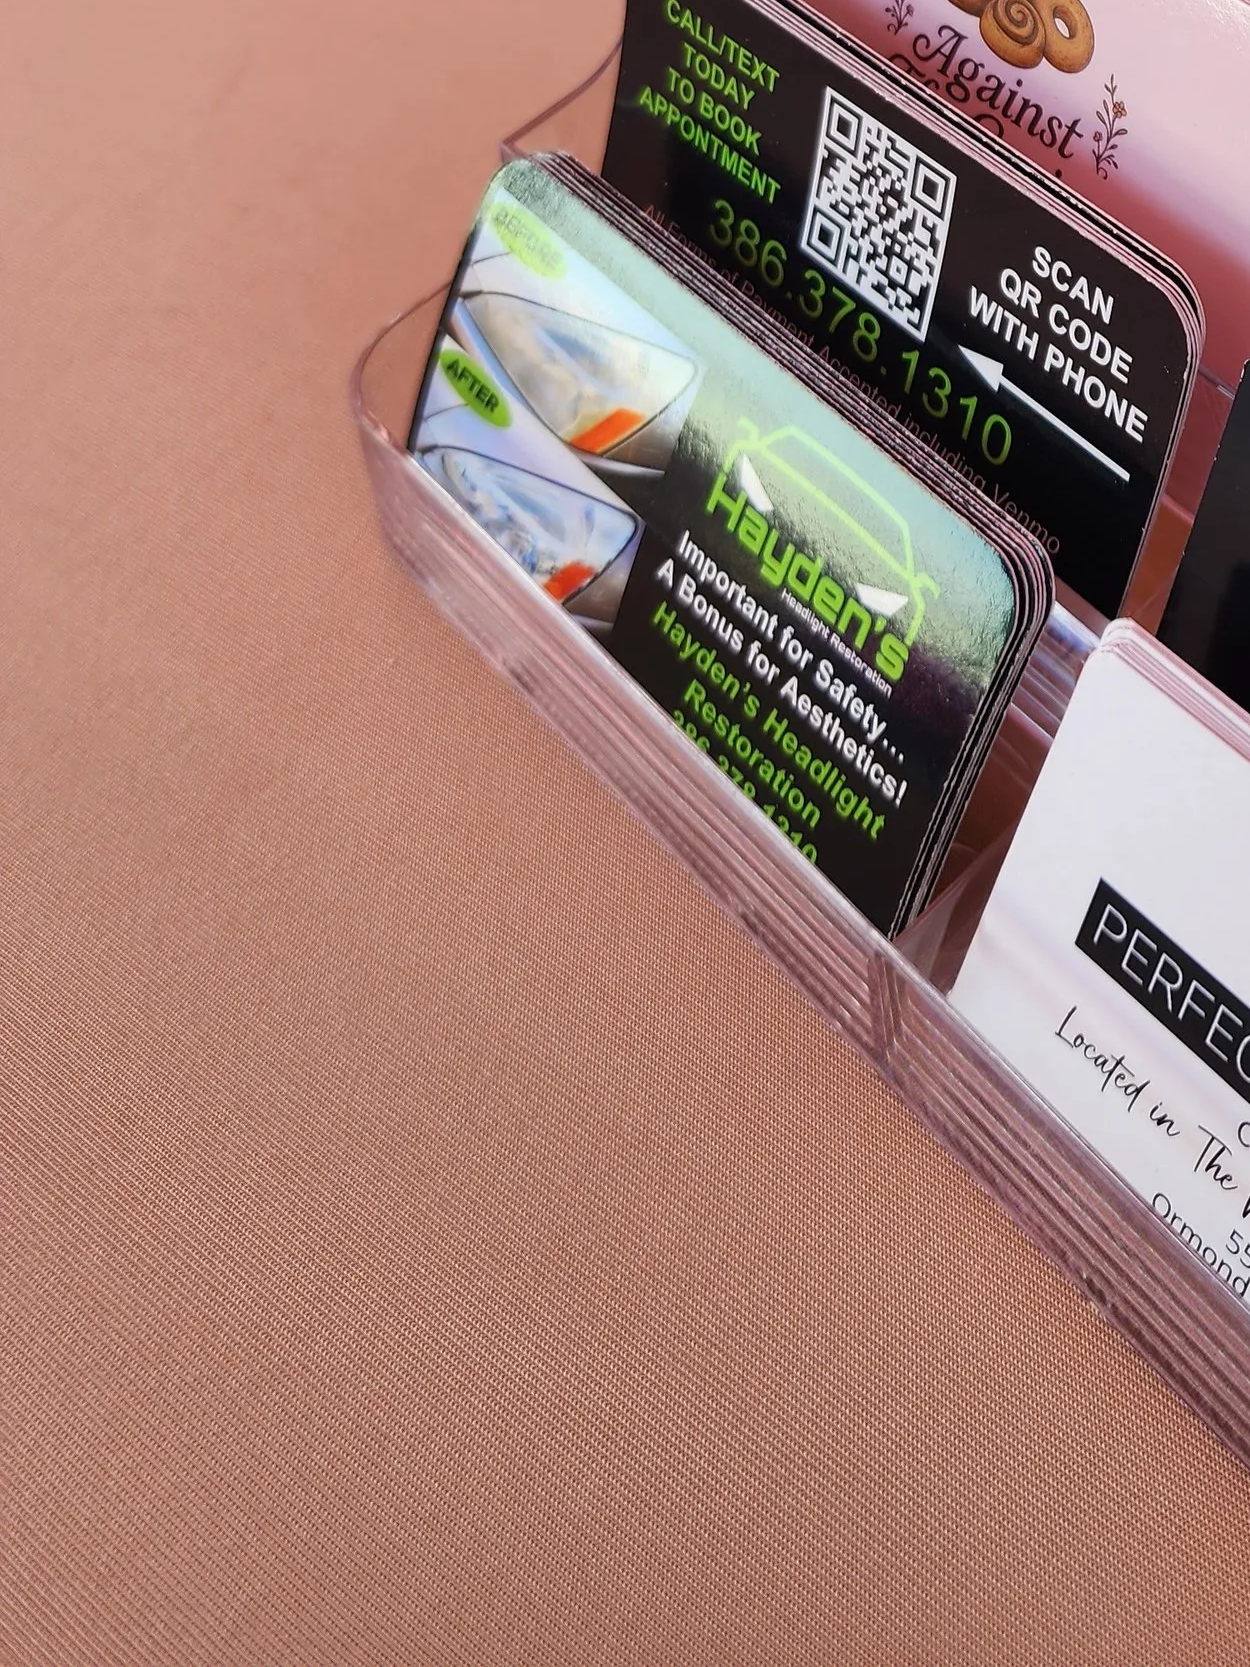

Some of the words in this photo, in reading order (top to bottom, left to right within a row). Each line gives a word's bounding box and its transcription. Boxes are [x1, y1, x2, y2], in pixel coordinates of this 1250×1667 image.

[638, 85, 782, 204] APPONTMENT
[669, 67, 695, 105] TO
[700, 91, 763, 156] BOOK
[684, 42, 756, 110] TODAY
[912, 24, 1084, 159] Against
[710, 199, 1012, 465] 386.378.1310
[1000, 268, 1042, 319] QR
[1049, 303, 1133, 384] CODE
[1032, 246, 1114, 325] SCAN
[446, 357, 500, 414] AFTER
[969, 285, 1040, 361] WITH
[1043, 343, 1149, 443] PHONE
[676, 529, 779, 639] Important
[778, 625, 814, 672] for
[814, 657, 905, 764] Safety...
[706, 471, 910, 681] Hayden's
[781, 587, 831, 640] Headlight
[829, 632, 893, 700] Restoration
[653, 600, 761, 718] Hayden's
[762, 707, 887, 840] Headlight
[657, 558, 676, 590] A
[677, 573, 745, 655] Bonus
[746, 639, 781, 684] for
[780, 675, 908, 808] Aesthetics!
[684, 678, 821, 829] Restoration
[1054, 1005, 1151, 1113] Located
[1150, 1102, 1181, 1137] in
[1193, 1124, 1239, 1191] The
